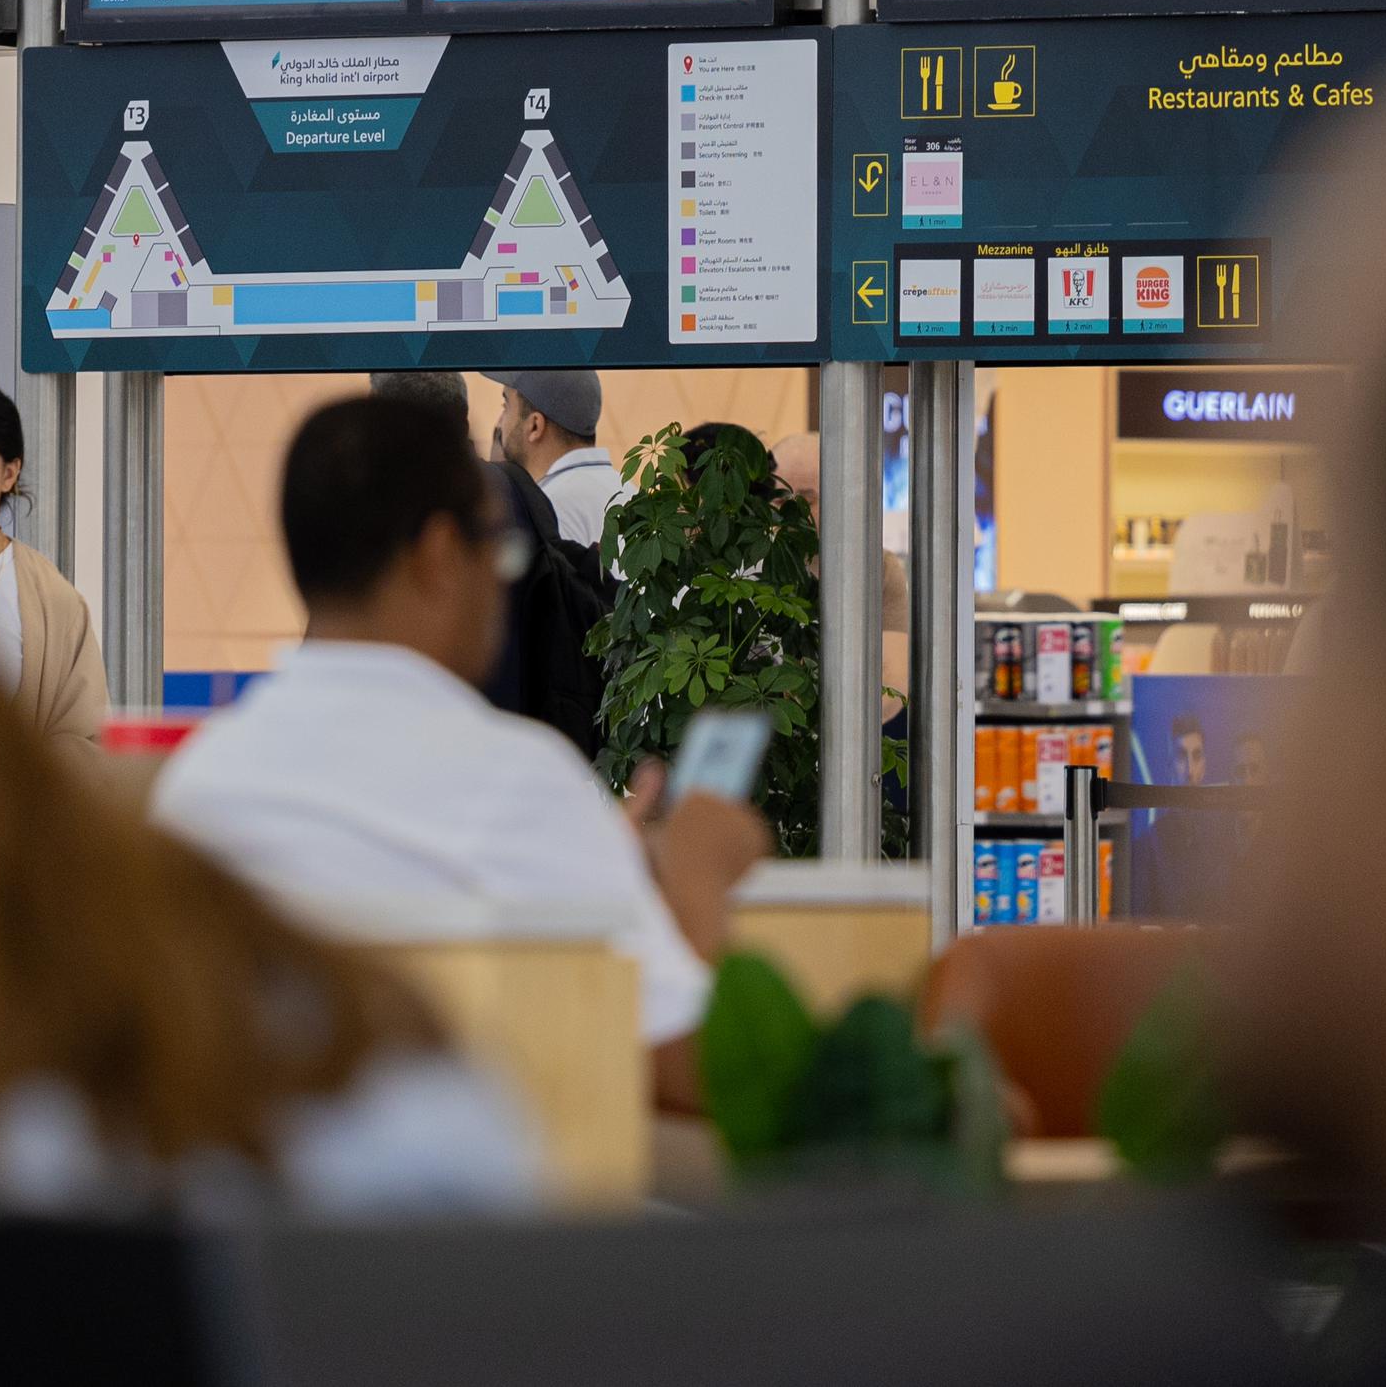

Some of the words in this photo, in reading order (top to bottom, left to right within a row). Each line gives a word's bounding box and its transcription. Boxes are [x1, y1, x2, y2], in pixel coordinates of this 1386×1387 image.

[280, 59, 315, 74] الدولي
[318, 58, 339, 68] خالد
[342, 57, 371, 67] الملك
[374, 57, 399, 69] مطار
[1179, 46, 1267, 79] ومقاهي
[1274, 43, 1342, 76] مطاعم
[280, 74, 302, 86] king
[306, 73, 337, 83] khalid
[341, 71, 359, 82] int'l
[363, 72, 399, 84] airport
[1149, 87, 1279, 109] Restaurants
[1289, 84, 1304, 106] &
[1313, 82, 1373, 106] Cafes
[528, 93, 547, 115] T4
[128, 105, 146, 125] T3
[291, 108, 333, 125] المغادرة
[337, 109, 380, 124] مستوى
[287, 132, 349, 147] Departure
[354, 129, 384, 142] Level
[926, 142, 940, 150] 306
[978, 244, 1033, 255] Mezzanine
[1054, 243, 1083, 259] البهو
[1083, 243, 1109, 259] طابق
[1137, 280, 1169, 288] BURGER
[1137, 289, 1169, 301] KING
[699, 324, 723, 332] Smoking
[1163, 390, 1294, 421] GUERLAIN
